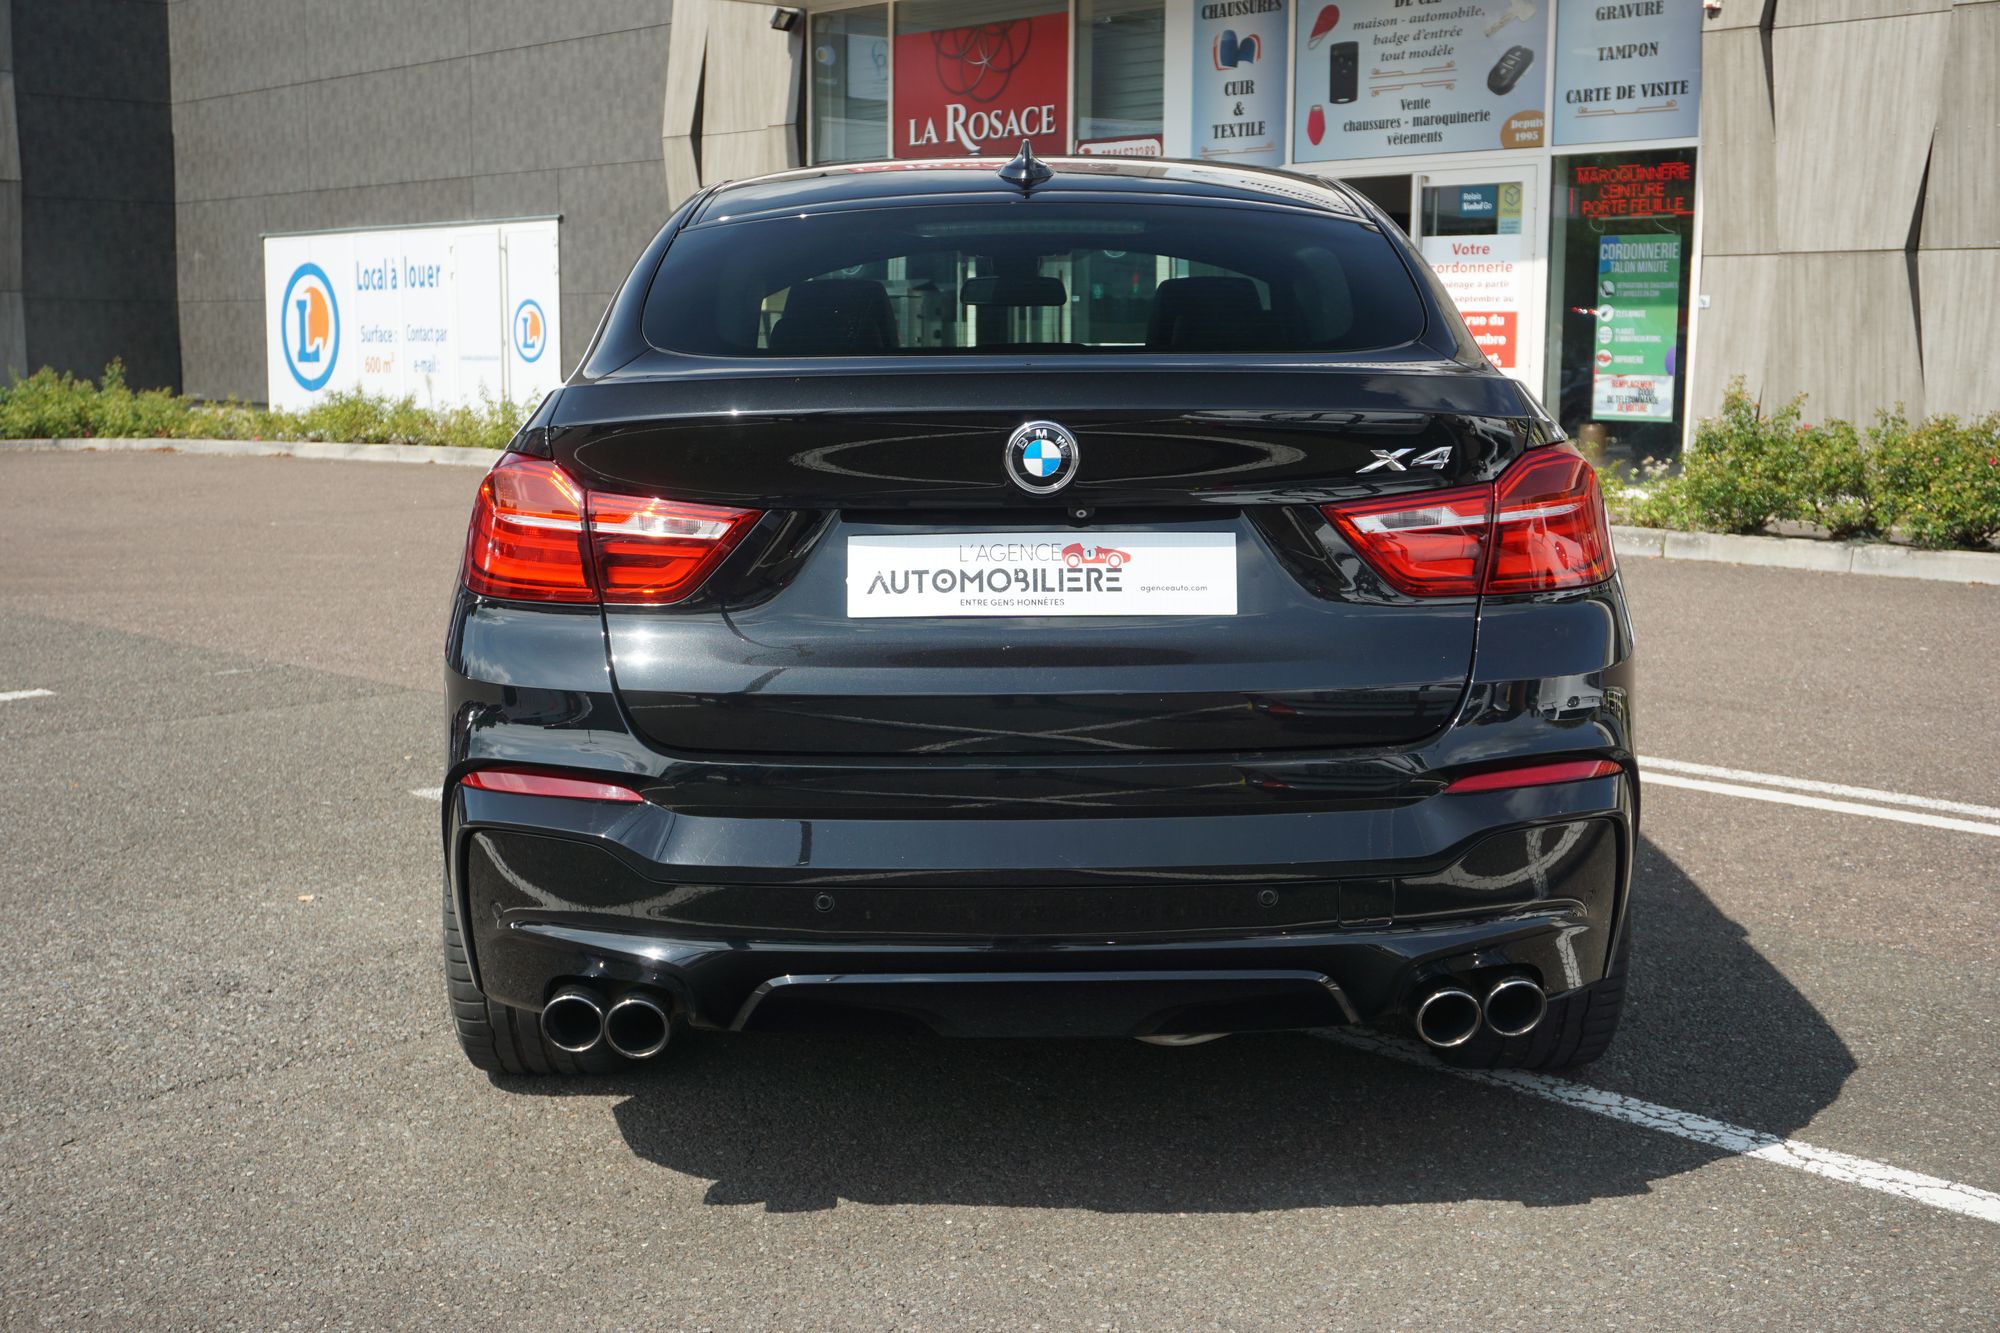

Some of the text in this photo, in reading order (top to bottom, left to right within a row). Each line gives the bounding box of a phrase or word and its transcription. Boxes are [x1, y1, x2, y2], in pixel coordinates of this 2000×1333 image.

[1201, 0, 1282, 20] CHAUSSURES
[1595, 0, 1664, 21] GRAVURE
[1352, 17, 1398, 31] maison
[1373, 26, 1463, 47] badge d'entrée
[1381, 44, 1455, 62] tout modèle
[1598, 42, 1659, 62] TAMPON
[1224, 80, 1255, 96] CUIR
[1566, 80, 1689, 104] CARTE DE VISITE
[1233, 102, 1245, 116] &
[1400, 98, 1431, 112] Vente
[909, 103, 1056, 151] LA ROSACE
[1213, 121, 1266, 139] TEXTILE
[1344, 116, 1401, 133] chaussures
[1412, 109, 1491, 130] maroquinerie
[1511, 117, 1544, 130] Depuis
[1387, 130, 1443, 146] vêtements
[1515, 131, 1539, 142] 1995
[1452, 243, 1490, 255] Votre
[1601, 242, 1679, 260] CORDONNERIE
[356, 256, 441, 291] Local à louer
[1611, 260, 1669, 273] TALON MINUTE
[360, 324, 393, 343] Surface
[407, 324, 447, 346] Contact par
[365, 356, 381, 373] 600
[1016, 428, 1069, 451] BMW
[1355, 446, 1452, 474] X4
[960, 543, 1062, 562] L'AGENCE
[1140, 584, 1208, 594] agenceauto.com
[960, 598, 988, 607] ENTRE
[991, 598, 1015, 607] GENS
